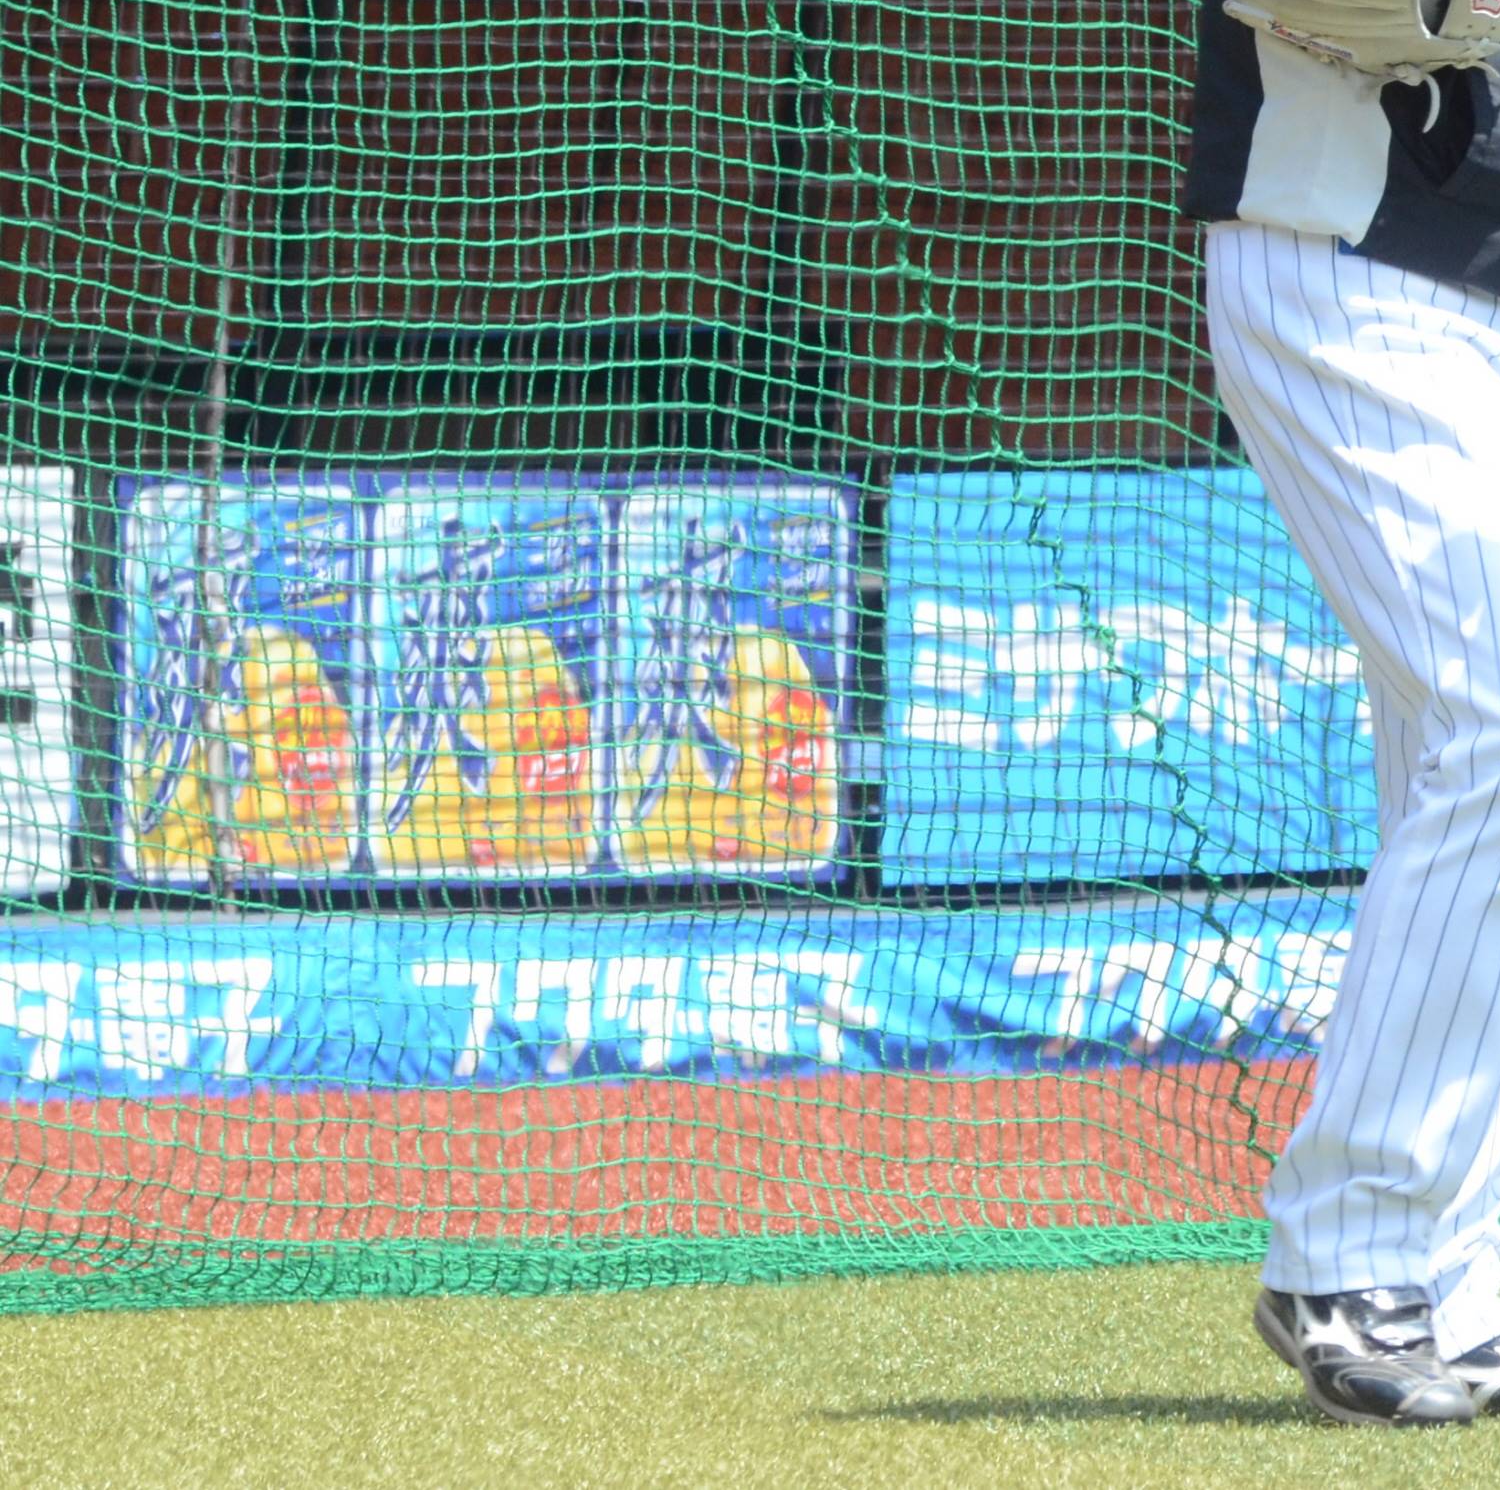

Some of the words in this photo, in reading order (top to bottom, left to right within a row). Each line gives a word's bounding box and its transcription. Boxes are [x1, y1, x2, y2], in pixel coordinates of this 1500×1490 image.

[901, 595, 1374, 750] ミサワホー
[411, 952, 879, 1077] フクダ電子
